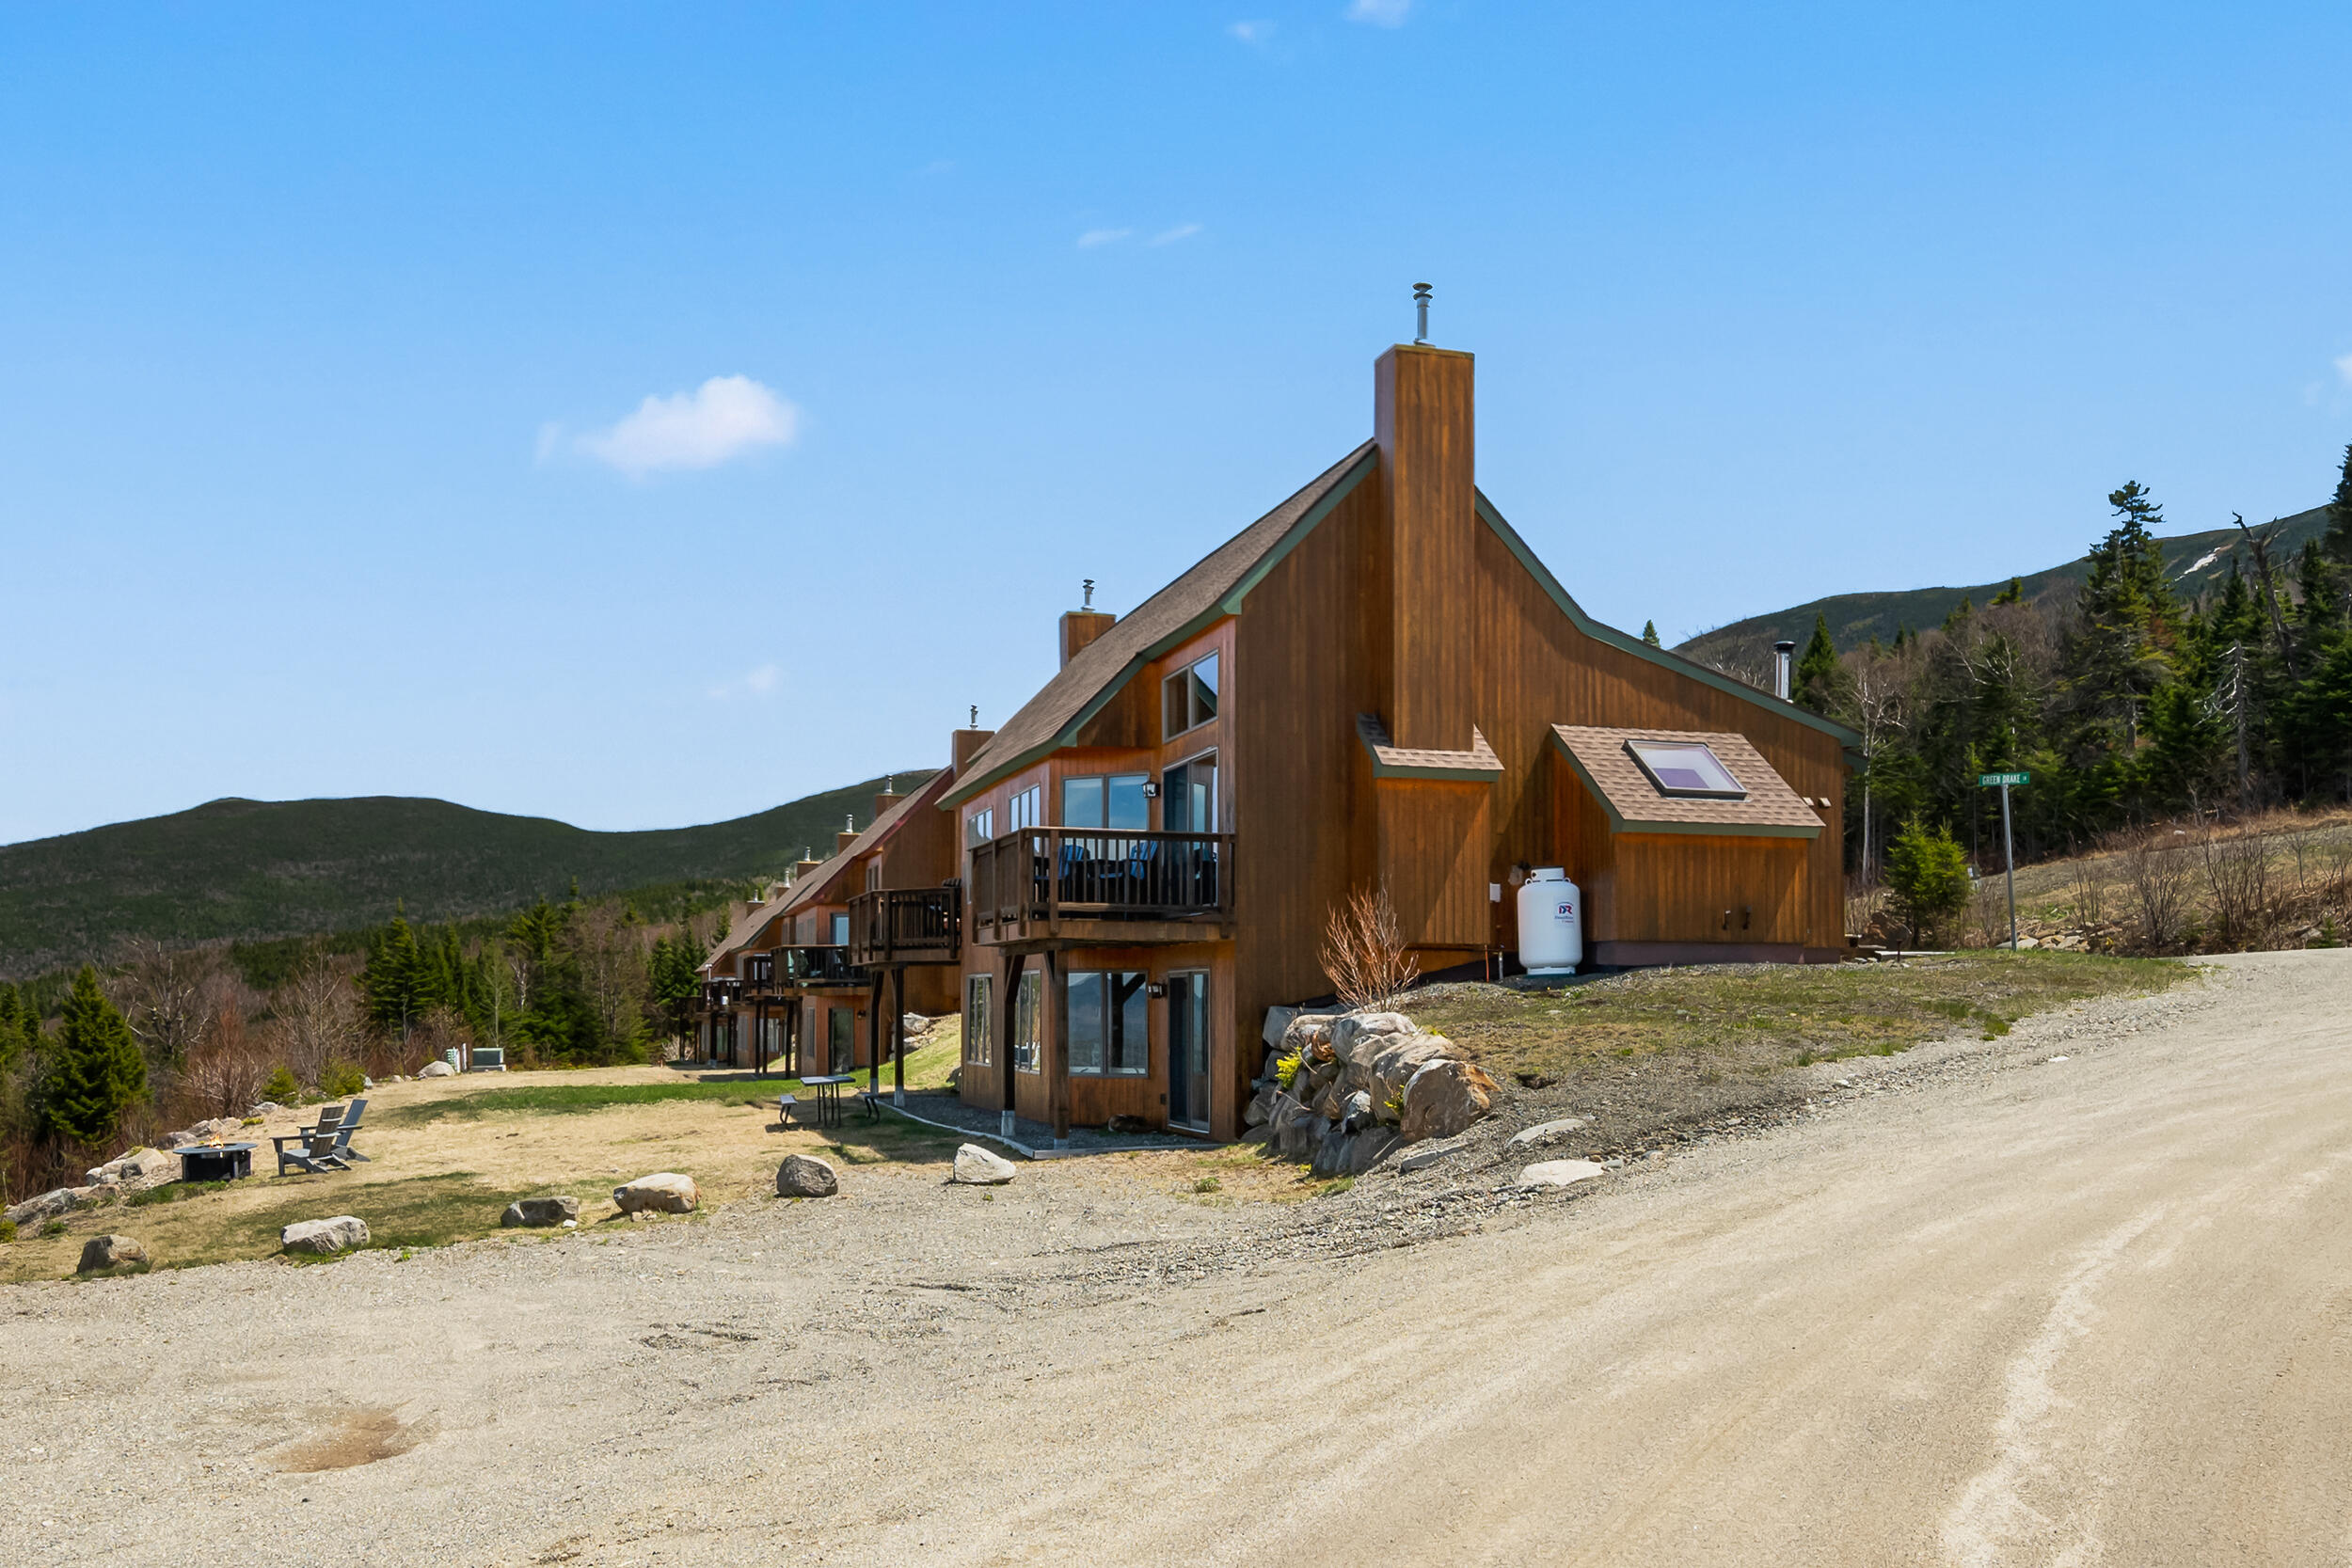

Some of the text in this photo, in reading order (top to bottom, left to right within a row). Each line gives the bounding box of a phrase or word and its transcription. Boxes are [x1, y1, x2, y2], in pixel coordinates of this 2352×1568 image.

[1982, 775, 2001, 784] GREEN
[2002, 774, 2021, 784] DRAKE
[1558, 905, 1573, 914] DR
